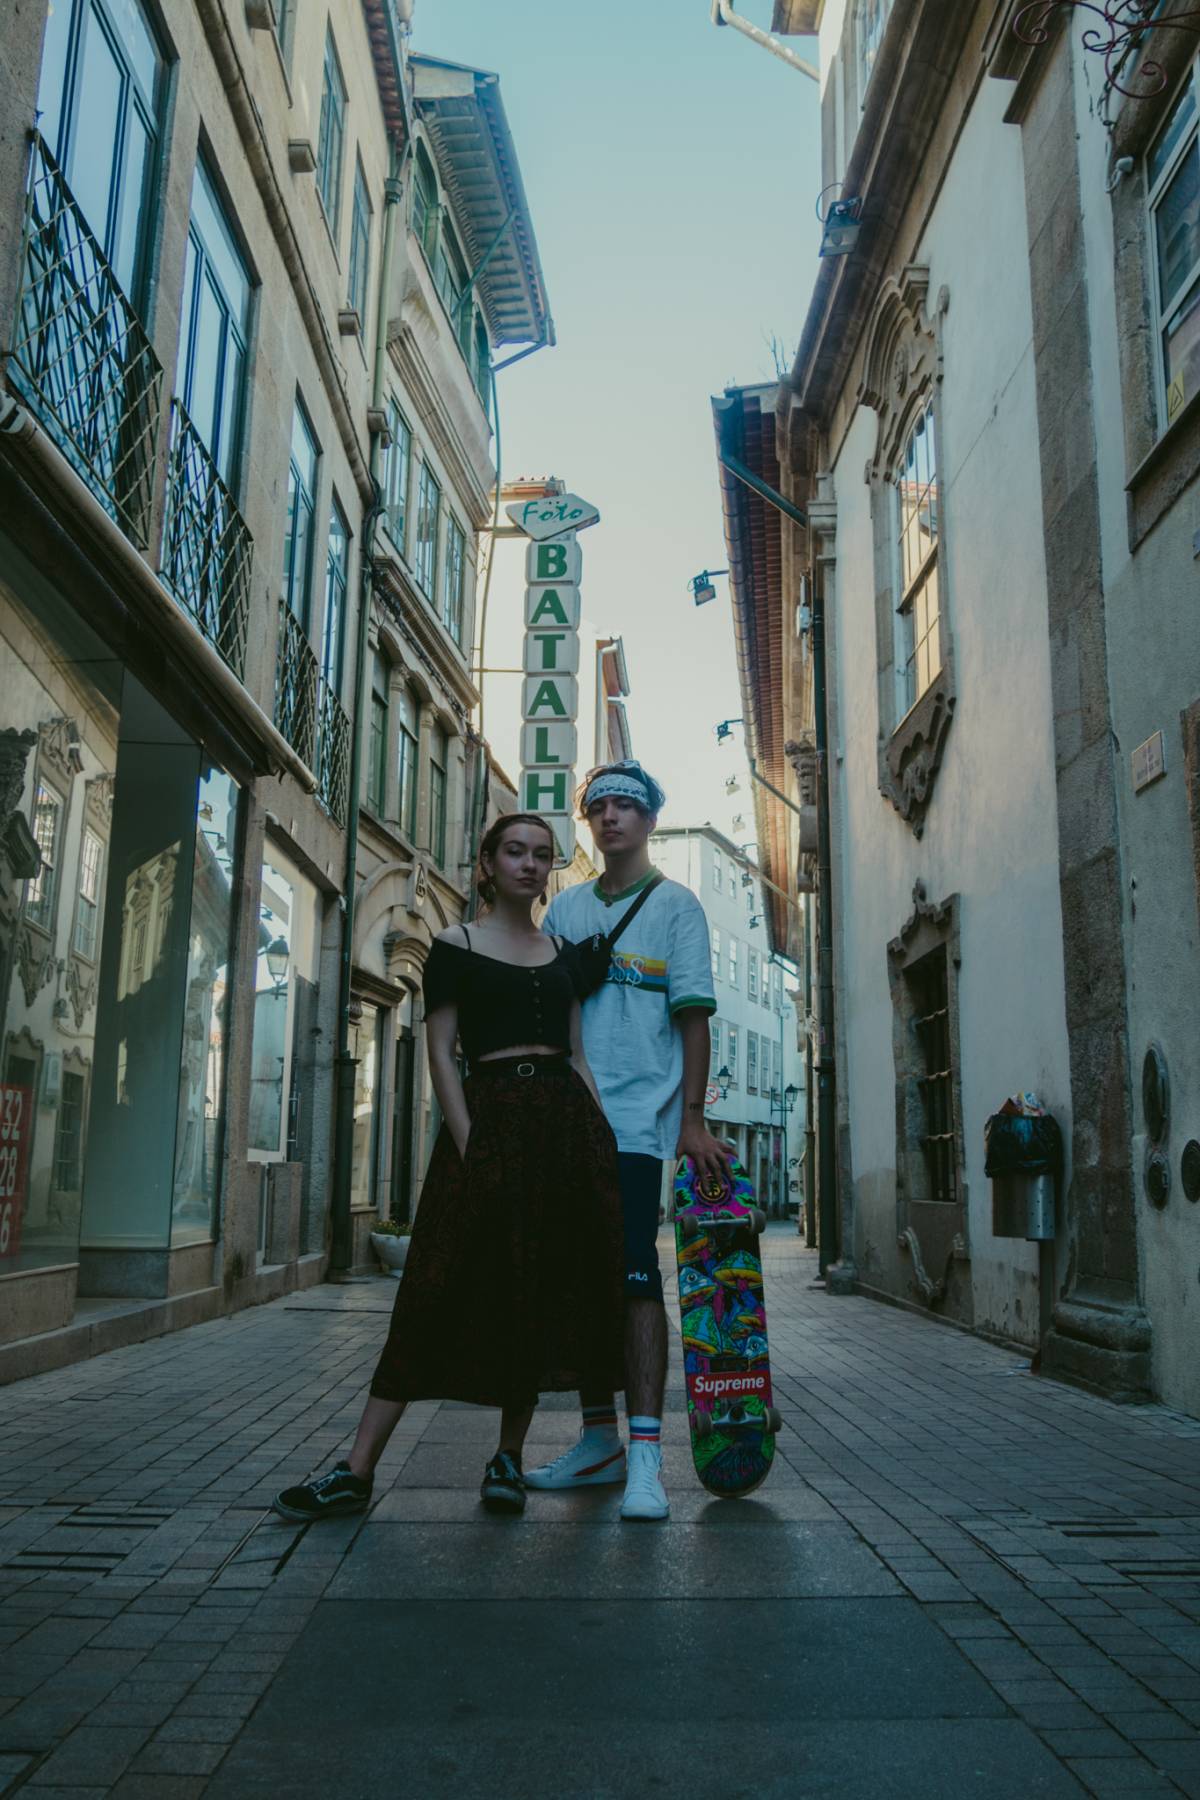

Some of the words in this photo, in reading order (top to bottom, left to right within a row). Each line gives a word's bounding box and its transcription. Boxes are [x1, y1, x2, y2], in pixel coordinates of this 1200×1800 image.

[522, 501, 584, 526] Foto
[0, 1088, 23, 1141] 32
[0, 1201, 13, 1253] 6
[694, 1376, 765, 1397] Supreme
